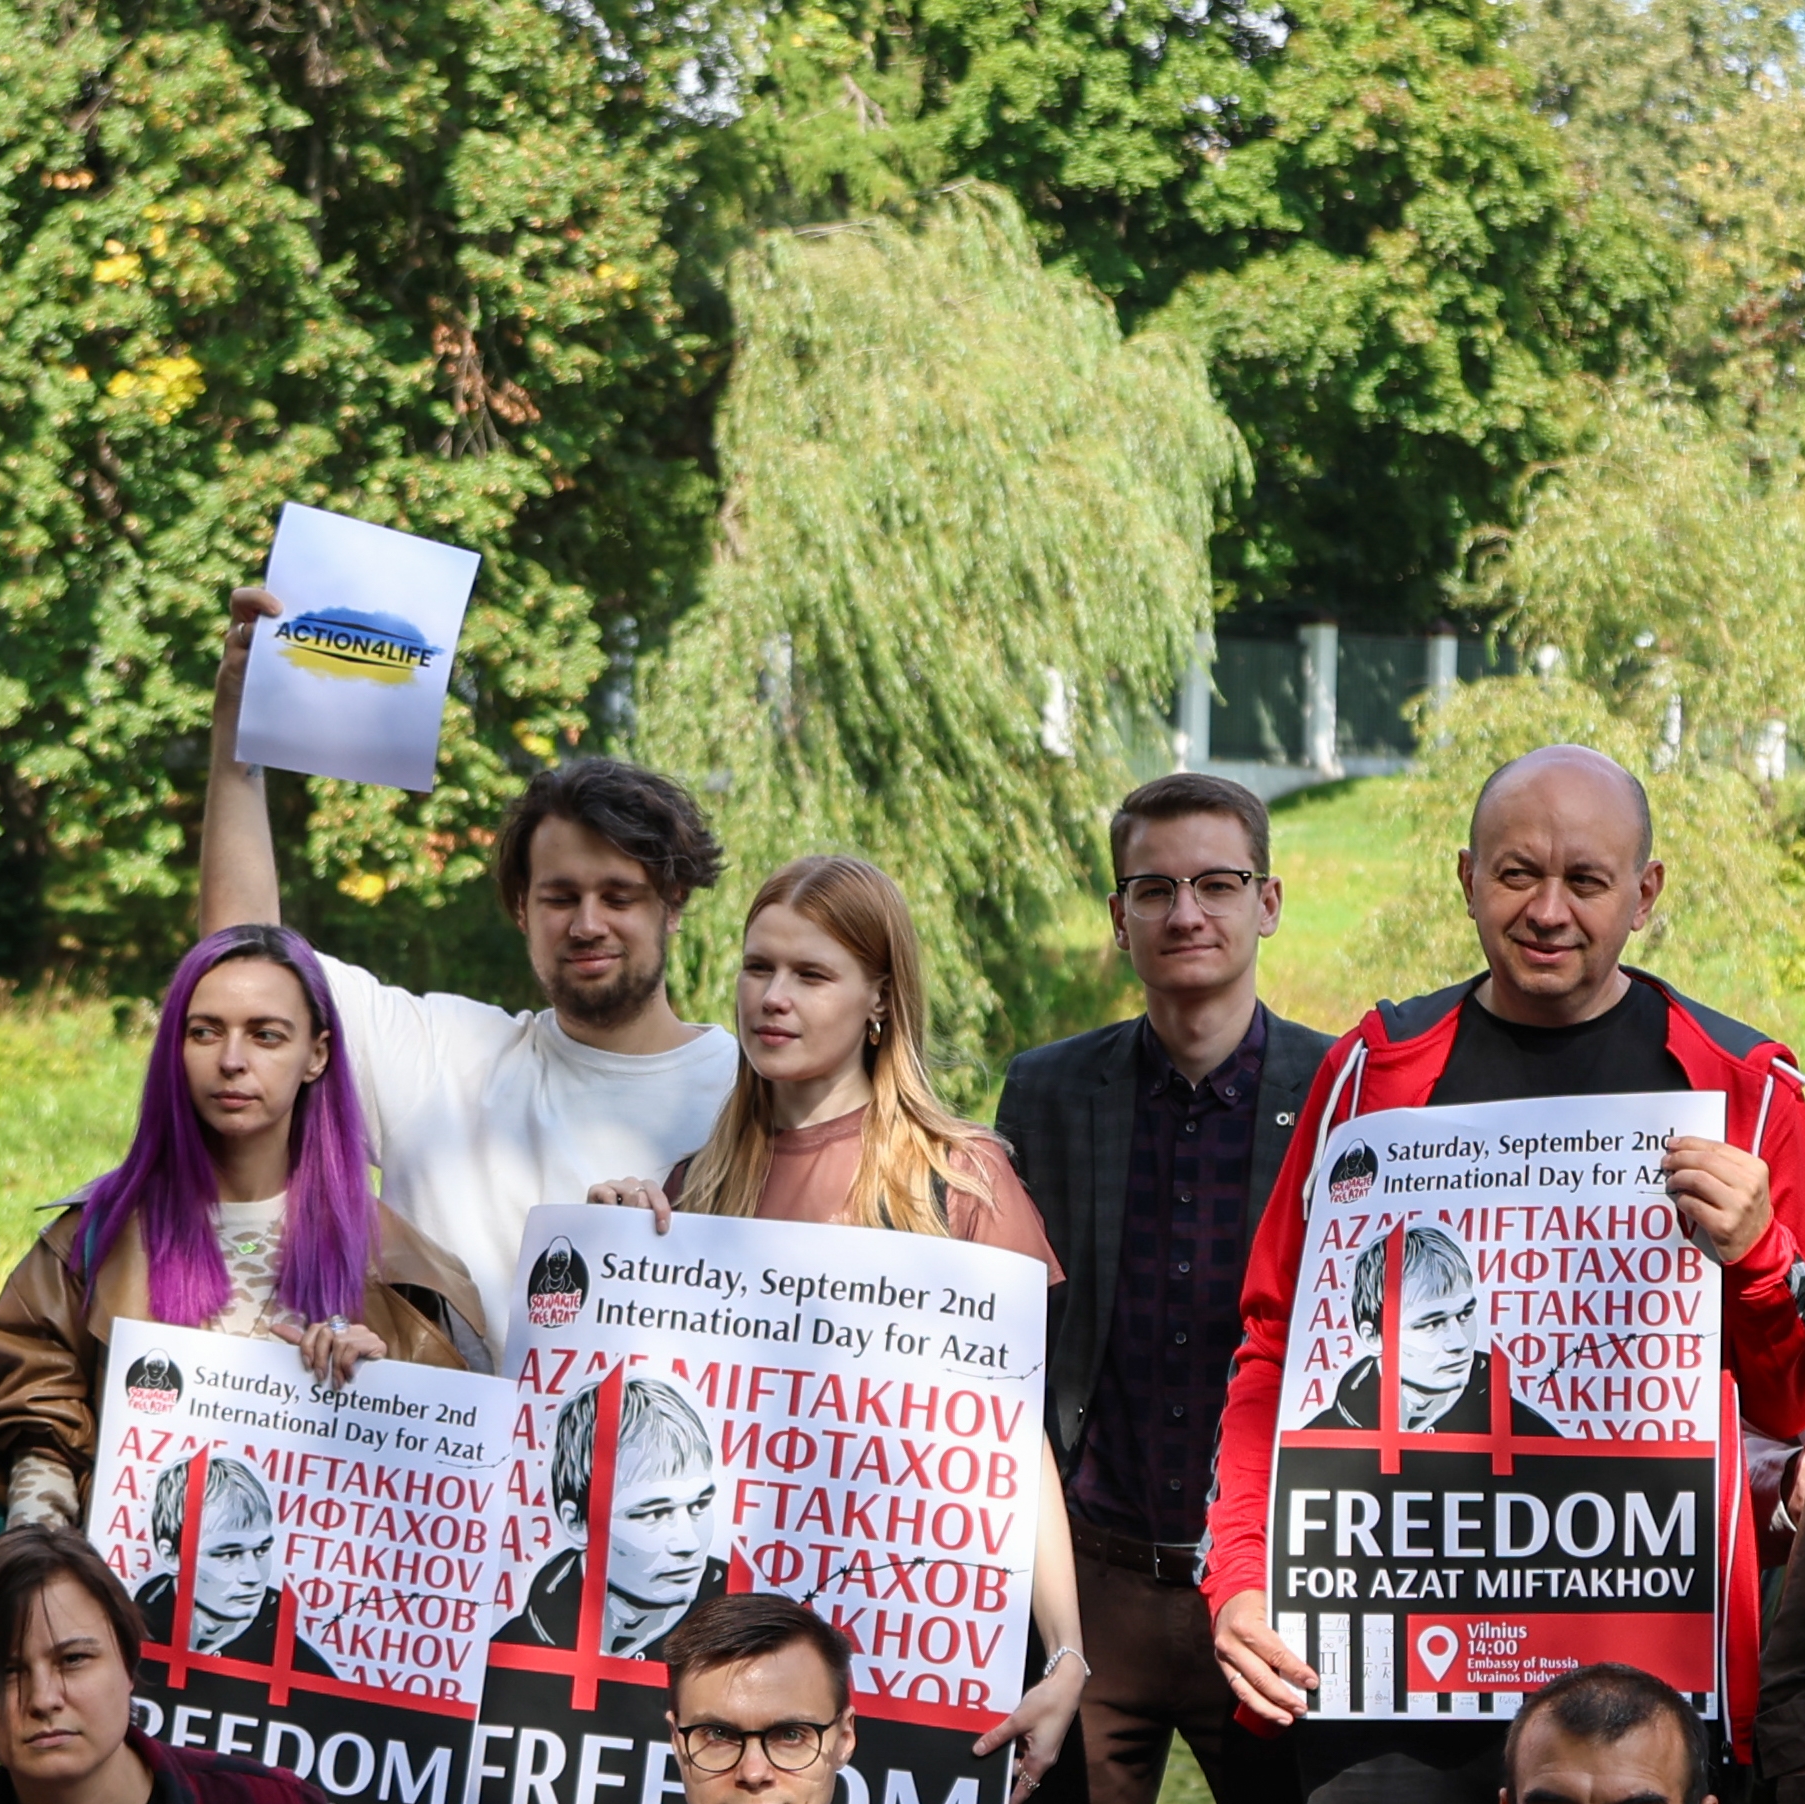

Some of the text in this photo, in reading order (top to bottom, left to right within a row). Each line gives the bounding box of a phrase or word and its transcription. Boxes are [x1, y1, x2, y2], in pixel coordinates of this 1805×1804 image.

[275, 621, 435, 668] ACTION4LIFE
[1386, 1135, 1489, 1162] Saturday,
[1498, 1129, 1623, 1159] September
[1383, 1162, 1626, 1194] International Day for
[602, 1253, 994, 1320] Saturday, September 2nd
[597, 1298, 1008, 1369] International Day for Azat
[192, 1365, 476, 1427] Saturday, September 2nd
[189, 1397, 484, 1462] International Day for Azat
[1288, 1488, 1694, 1558] FREEDOM
[1287, 1563, 1693, 1599] FOR AZAT MIFTAKHOV
[1465, 1621, 1528, 1638] Vilnius
[1466, 1640, 1518, 1654] 14:00
